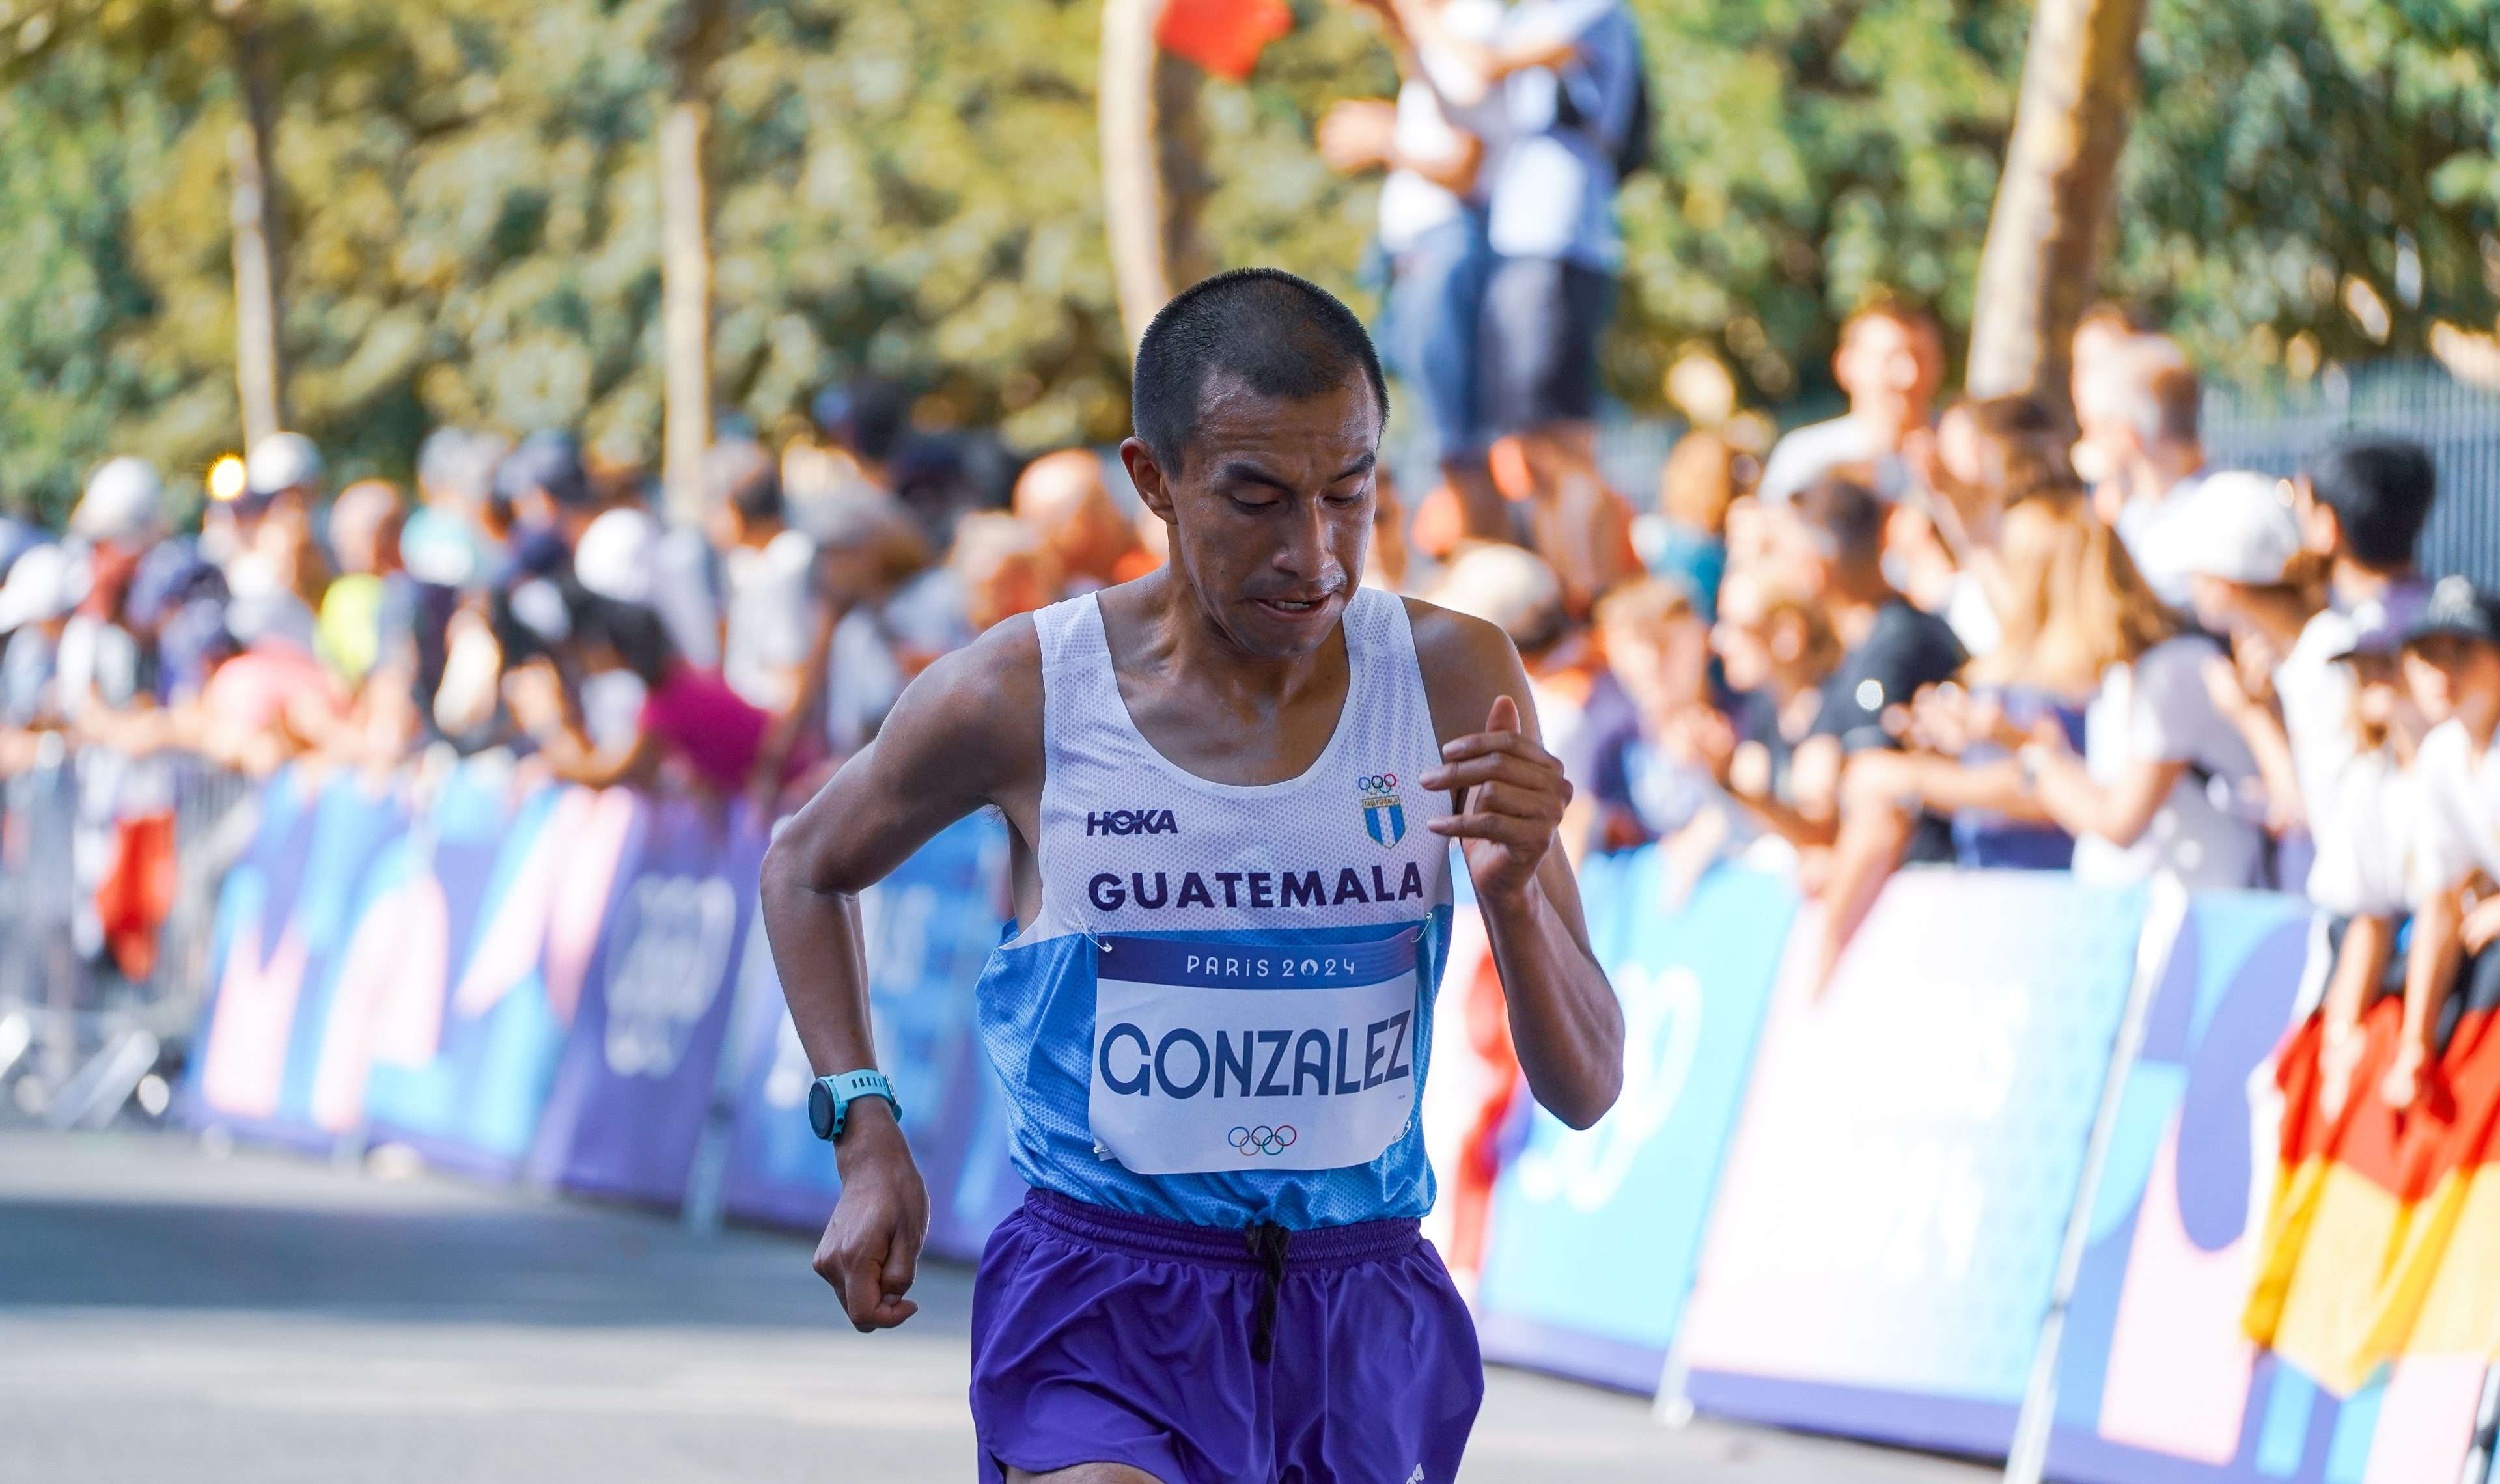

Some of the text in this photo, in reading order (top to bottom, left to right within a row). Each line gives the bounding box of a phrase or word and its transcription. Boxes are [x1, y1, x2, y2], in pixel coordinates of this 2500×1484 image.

[1086, 810, 1178, 836] HOKA
[1088, 862, 1423, 911] GUATEMALA
[1282, 958, 1354, 976] 2024
[1099, 1009, 1411, 1099] GONZALEZ
